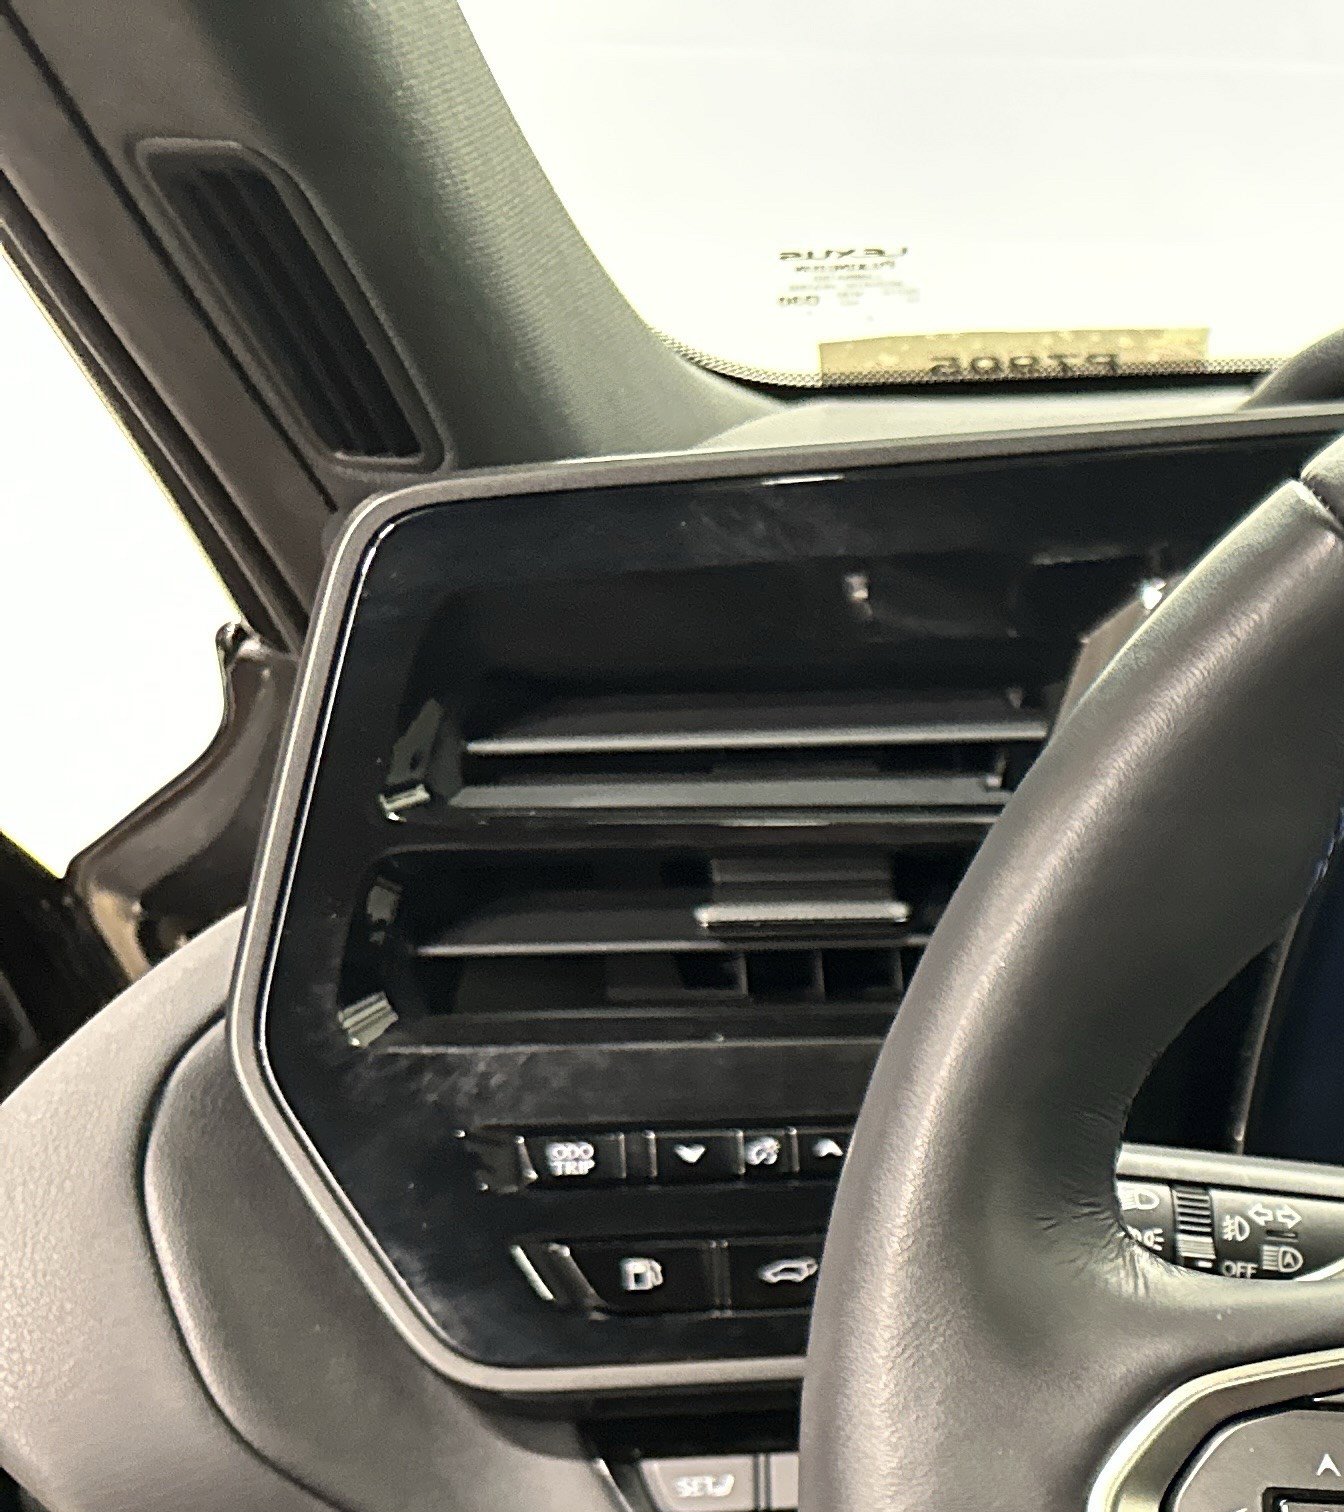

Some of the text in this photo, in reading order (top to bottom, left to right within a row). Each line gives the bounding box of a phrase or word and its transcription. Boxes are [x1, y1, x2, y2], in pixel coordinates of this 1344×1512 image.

[546, 1141, 595, 1160] ODO
[549, 1159, 596, 1177] TRIP
[1222, 1260, 1258, 1278] OFF
